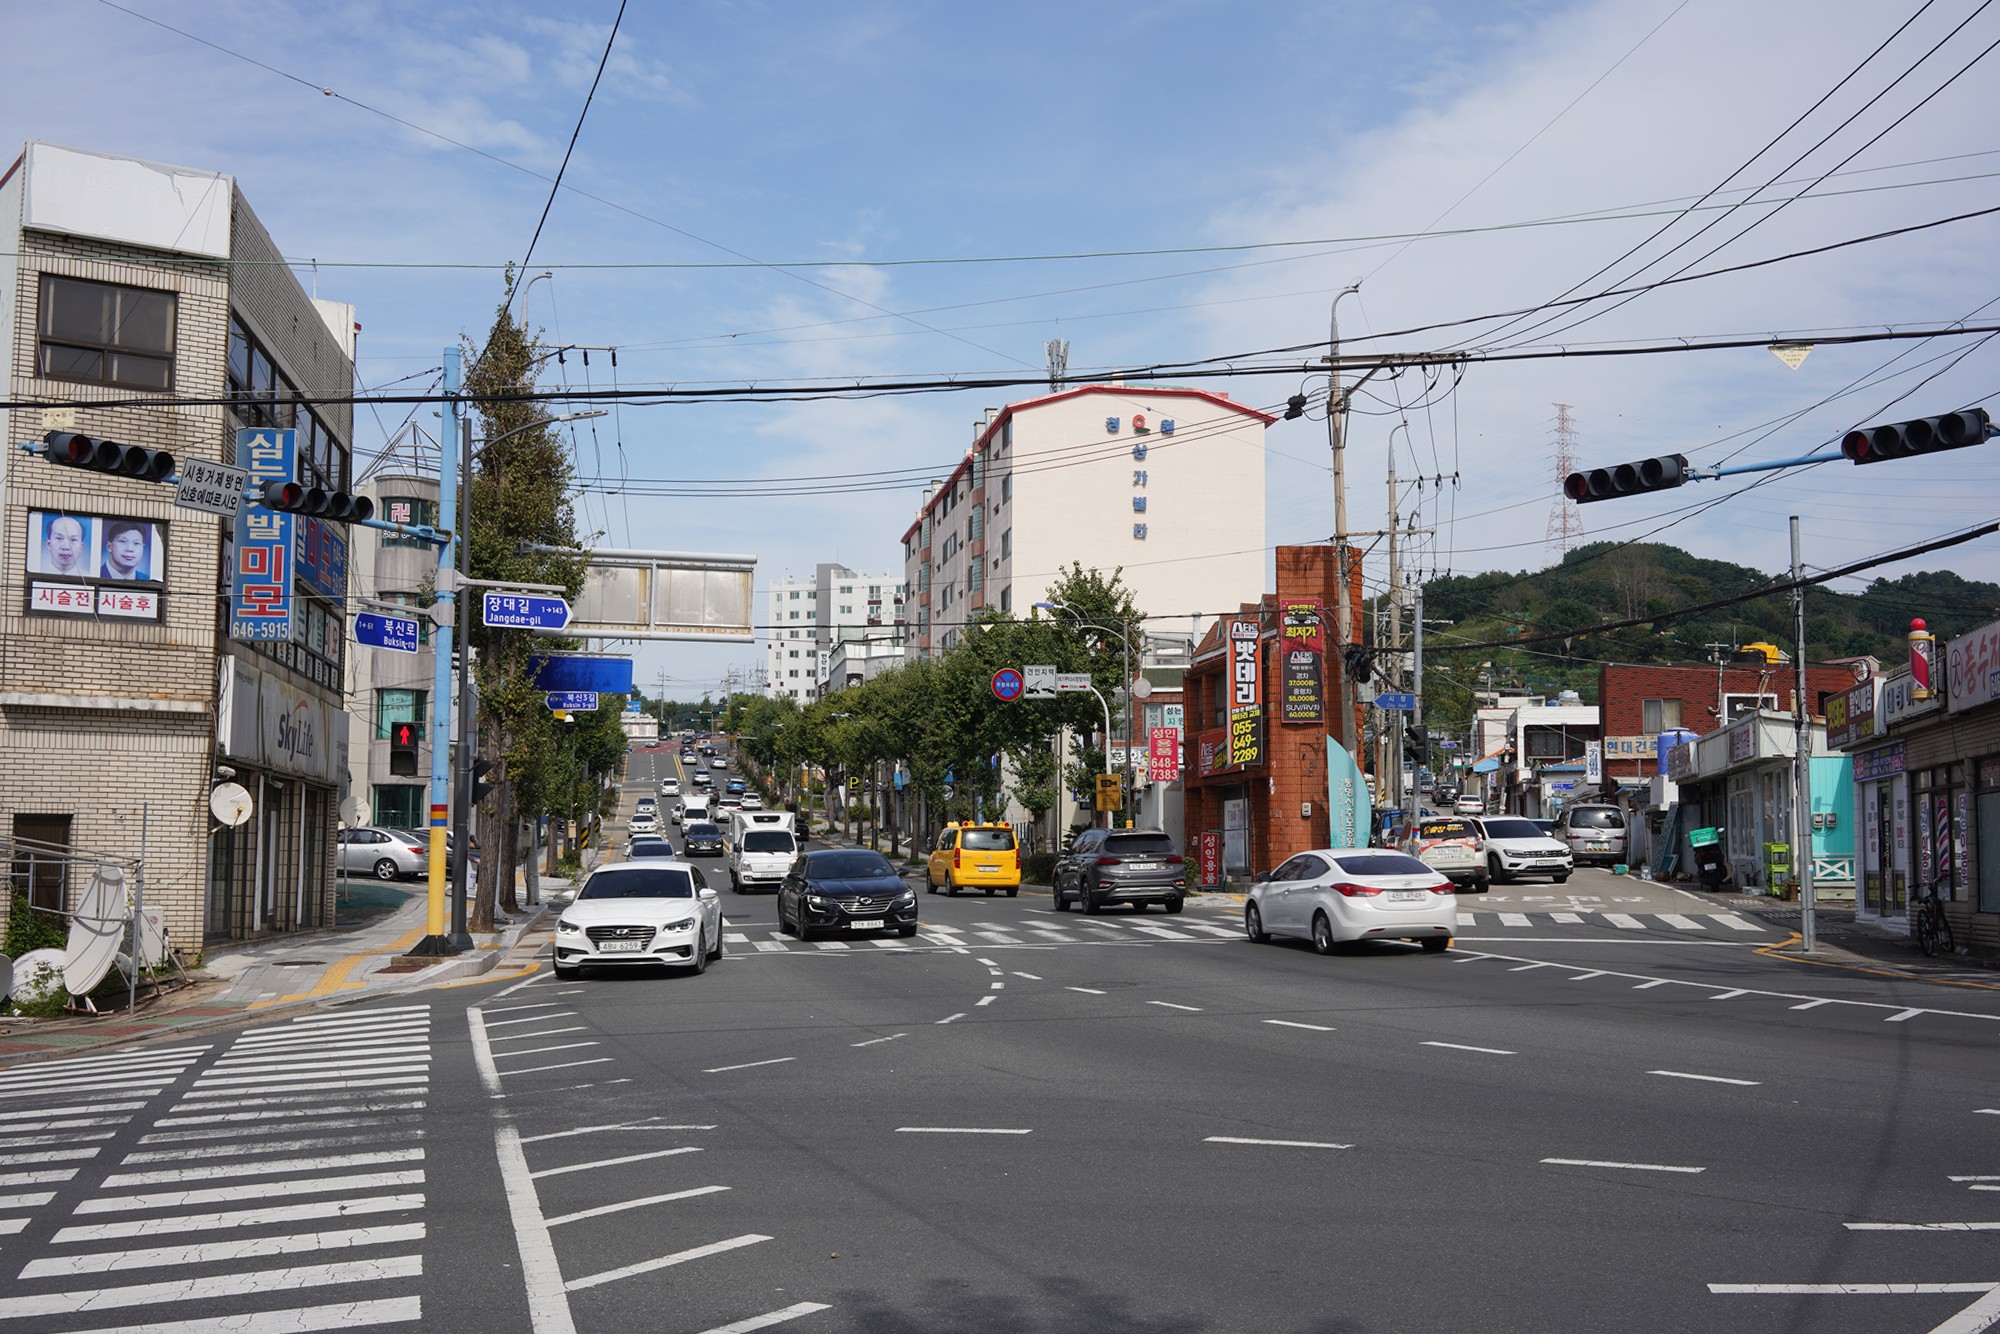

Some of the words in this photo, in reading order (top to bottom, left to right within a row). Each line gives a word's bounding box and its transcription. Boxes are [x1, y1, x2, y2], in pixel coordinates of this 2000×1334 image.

[185, 464, 244, 492] 시청거제방면
[245, 432, 287, 540] 심는발
[180, 485, 238, 511] 신호에따르시오
[237, 544, 289, 618] 미모
[101, 593, 152, 612] 시술후
[489, 596, 530, 614] 장대길
[384, 618, 416, 637] 북신로
[489, 612, 542, 626] Jangdae-gil
[231, 621, 289, 639] 646-5915
[383, 635, 416, 650] Buksin-ro
[1027, 667, 1055, 677] 견인지역
[1235, 641, 1258, 704] 밧데리
[1849, 683, 1873, 718] 할인매장
[1152, 728, 1177, 739] 성인
[1232, 720, 1257, 736] 055-
[1233, 734, 1257, 750] 649-
[1151, 757, 1176, 769] 648-
[1232, 746, 1258, 764] 2289
[1151, 769, 1178, 780] 7383
[1204, 835, 1217, 884] 성인용품
